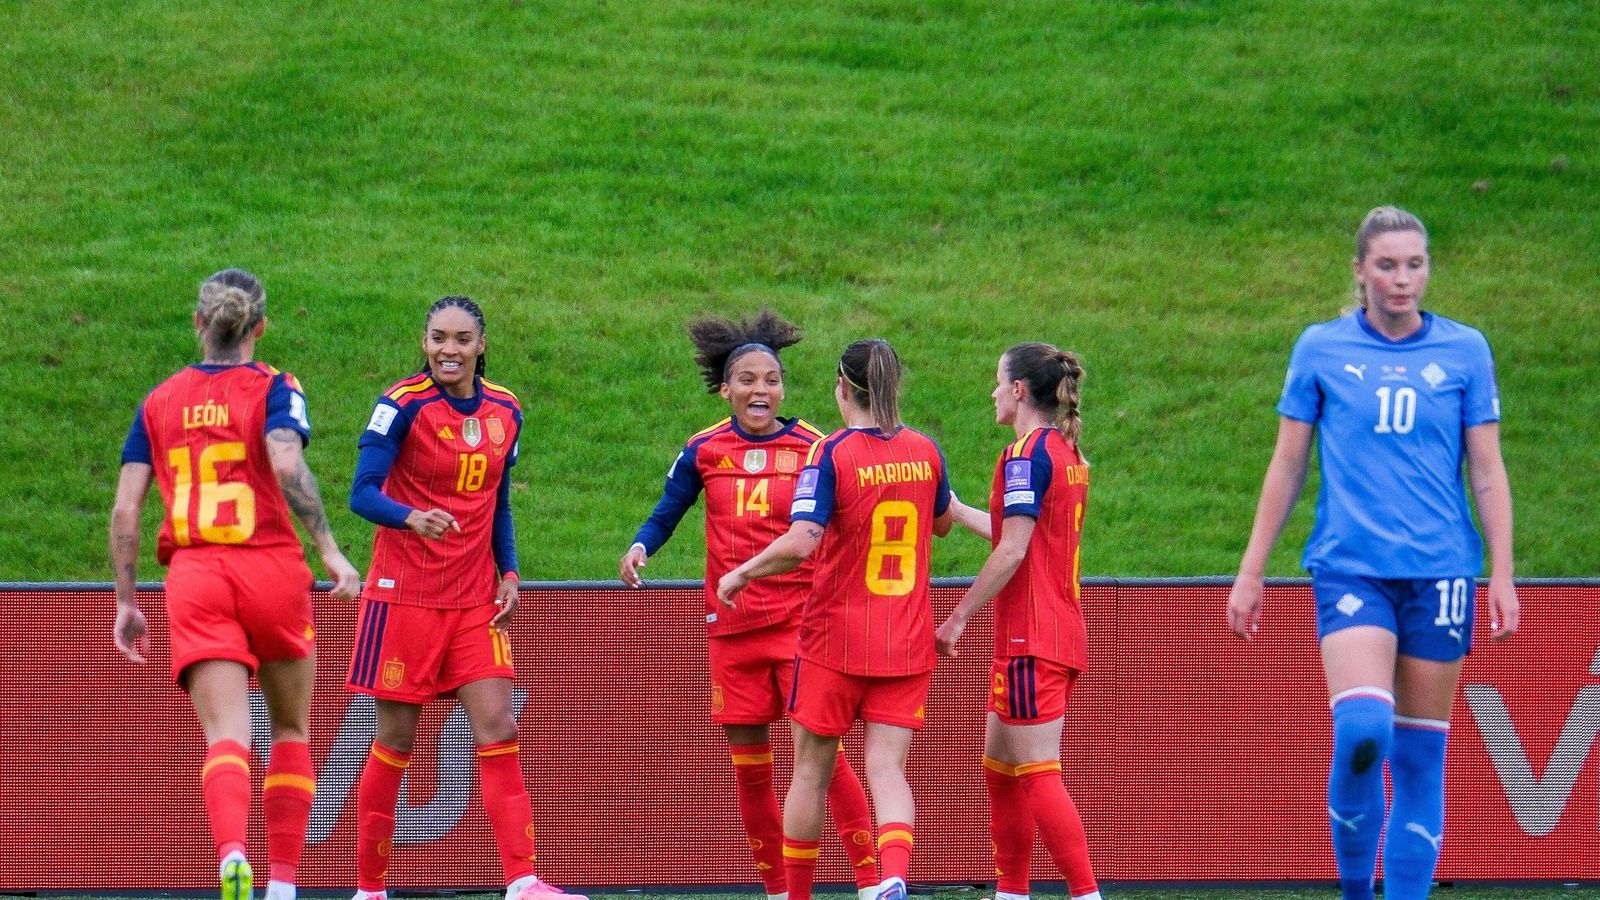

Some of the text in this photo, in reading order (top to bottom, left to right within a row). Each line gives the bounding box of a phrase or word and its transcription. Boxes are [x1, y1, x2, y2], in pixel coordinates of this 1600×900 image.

[182, 400, 230, 430] LEÓN
[1374, 386, 1418, 435] 10
[167, 441, 257, 546] 16
[456, 453, 488, 492] 18
[857, 460, 933, 488] MARIONA
[735, 478, 770, 517] 14
[865, 500, 919, 597] 8
[1434, 577, 1468, 627] 10
